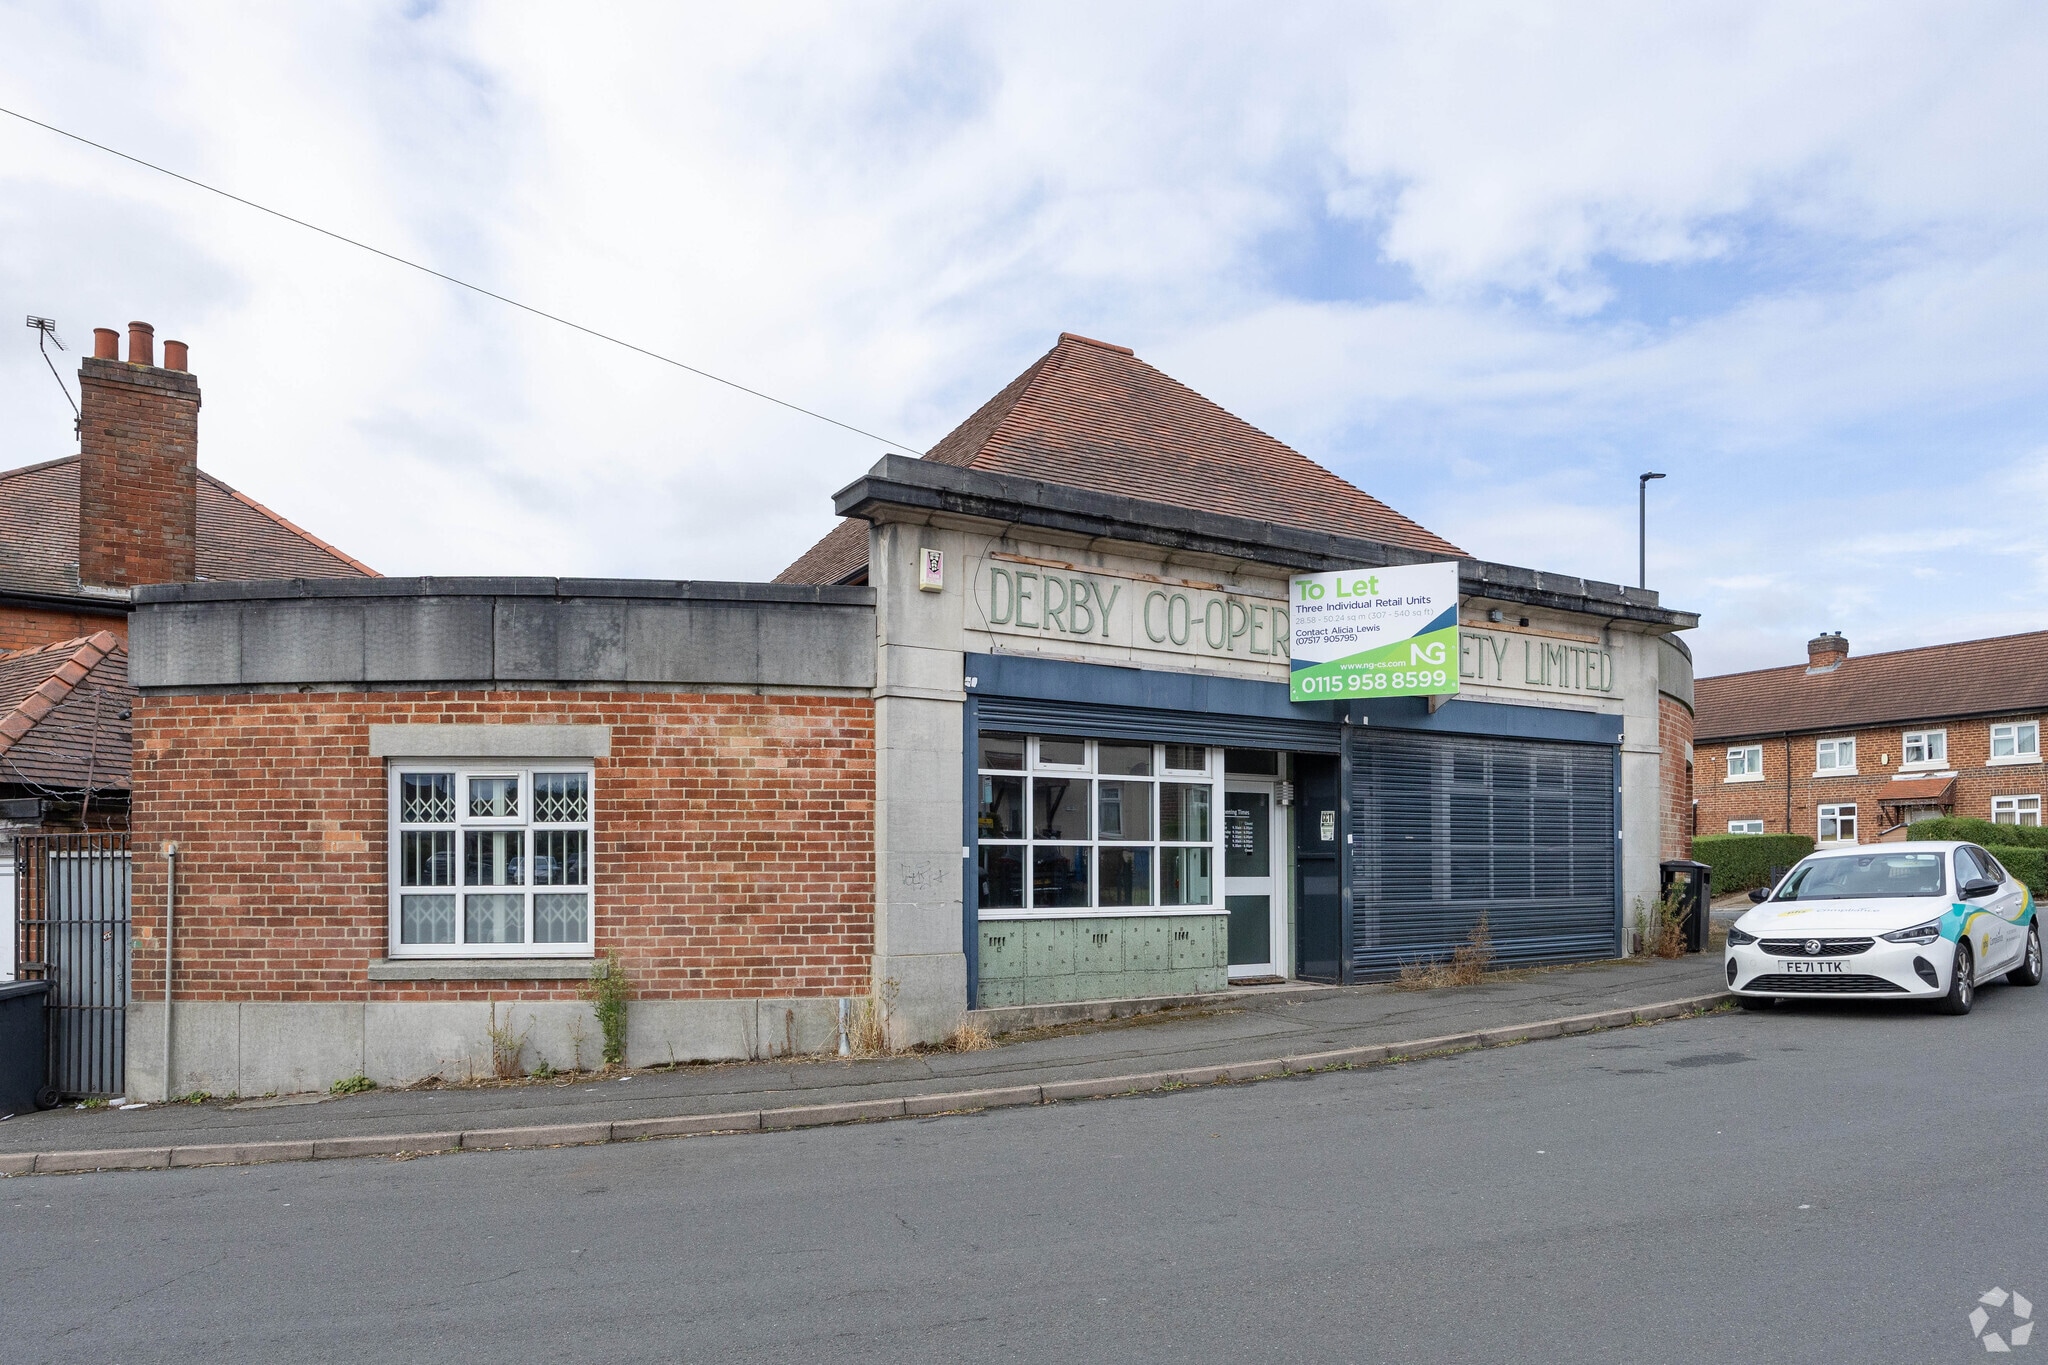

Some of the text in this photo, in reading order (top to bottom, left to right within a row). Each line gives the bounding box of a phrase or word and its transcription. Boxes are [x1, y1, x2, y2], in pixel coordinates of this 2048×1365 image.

[1295, 575, 1379, 601] To Let
[990, 567, 1121, 638] DERBY
[1295, 595, 1432, 613] Three Individual Retail Units
[1295, 616, 1317, 625] 28.58
[1323, 614, 1345, 623] 50.24
[1368, 611, 1386, 621] (307
[1394, 609, 1410, 618] 540
[1412, 610, 1422, 618] sq
[1424, 608, 1434, 616] ft)
[1295, 624, 1381, 637] Contact Alicia Lewis
[1295, 633, 1358, 646] (07517 905795)
[1410, 641, 1446, 667] NG
[1340, 660, 1407, 671] www.ng-cs.com
[1524, 639, 1613, 692] LIMITED
[1302, 670, 1447, 693] 0115 958 8599
[1786, 962, 1843, 973] FE71 TTK
